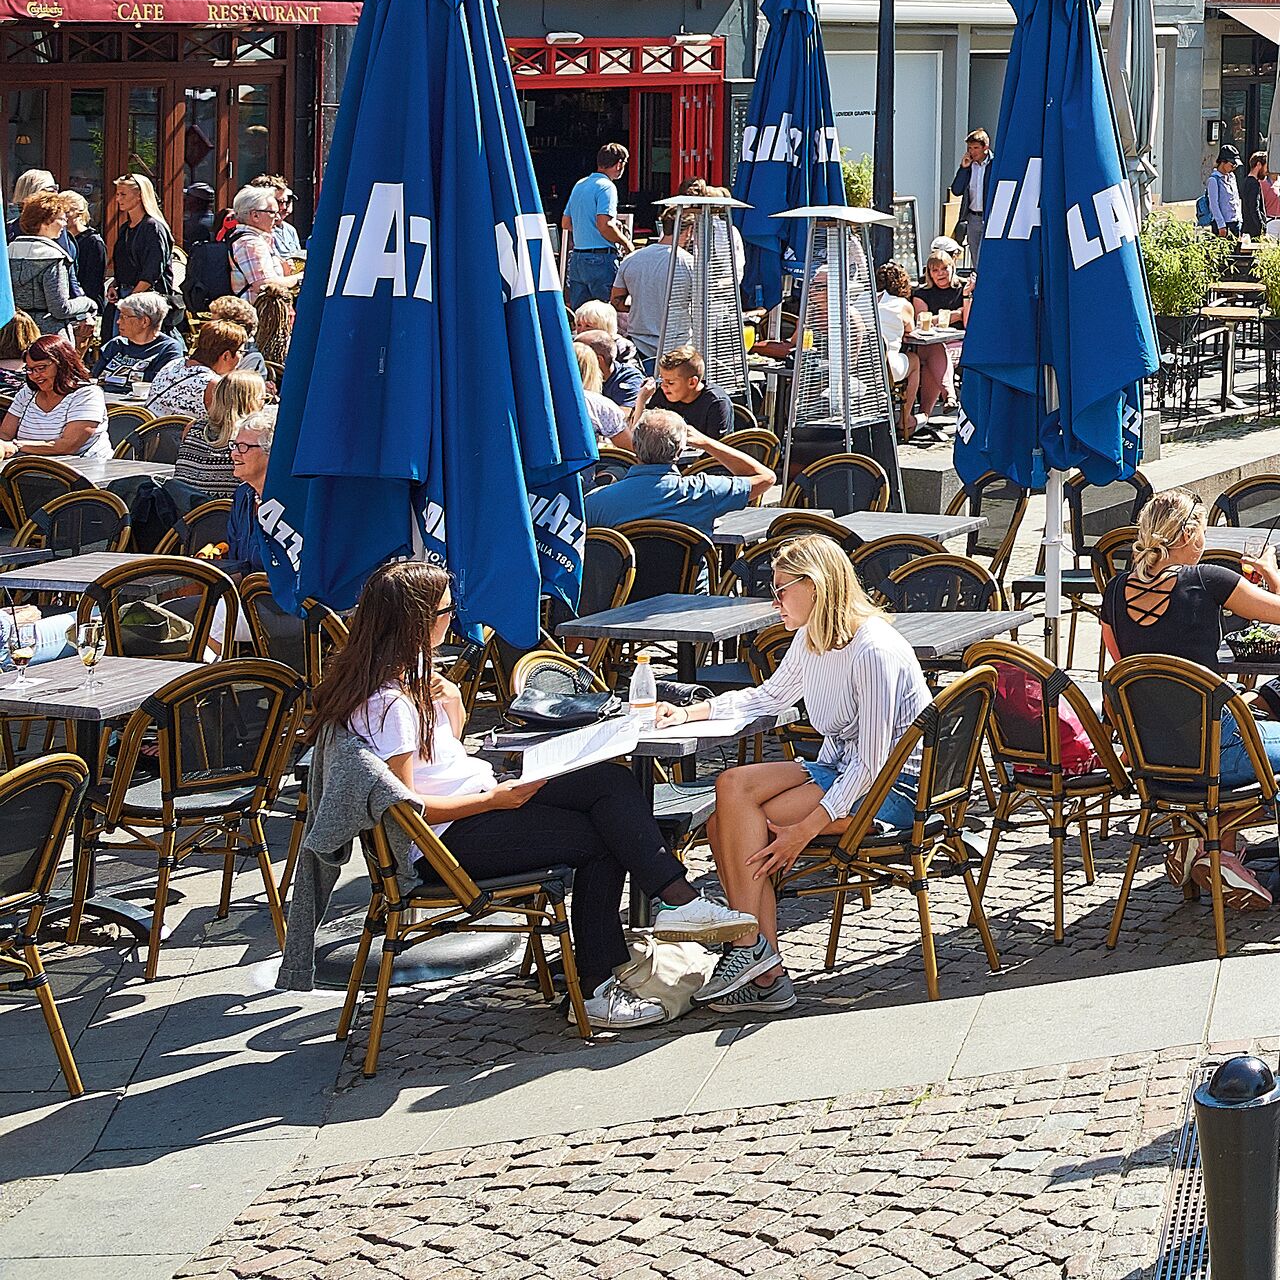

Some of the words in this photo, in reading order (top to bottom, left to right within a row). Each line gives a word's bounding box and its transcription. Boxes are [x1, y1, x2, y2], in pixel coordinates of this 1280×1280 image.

[26, 1, 64, 18] Carlsberg
[117, 3, 164, 21] CAFE
[208, 4, 322, 23] RESTAURANT
[555, 552, 575, 573] 1895
